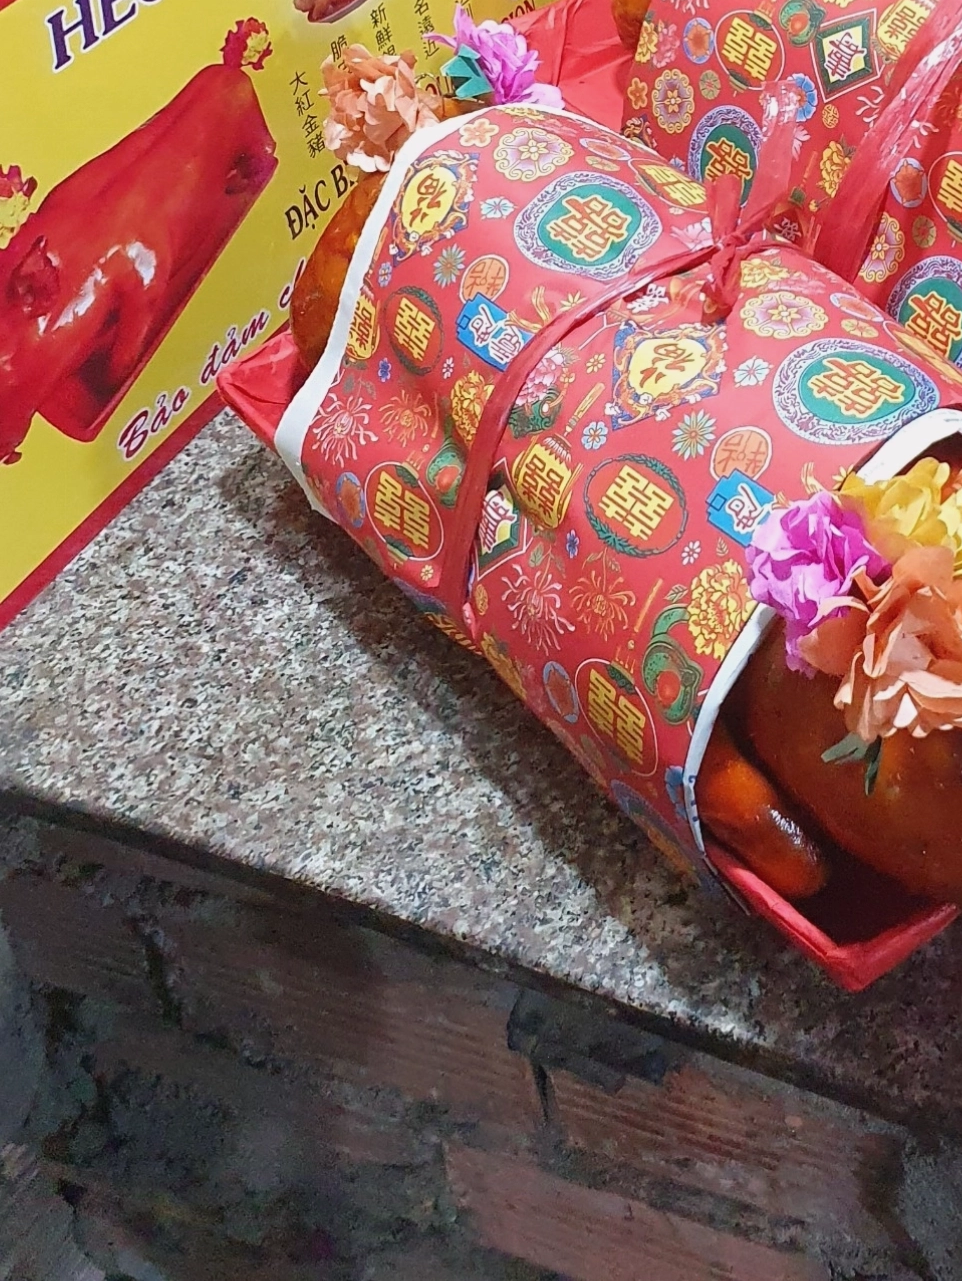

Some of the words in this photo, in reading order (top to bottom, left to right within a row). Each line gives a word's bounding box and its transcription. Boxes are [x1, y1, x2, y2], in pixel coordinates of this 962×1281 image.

[284, 183, 331, 241] ĐẶC
[118, 388, 190, 460] Bảo
[201, 311, 269, 385] đảm
